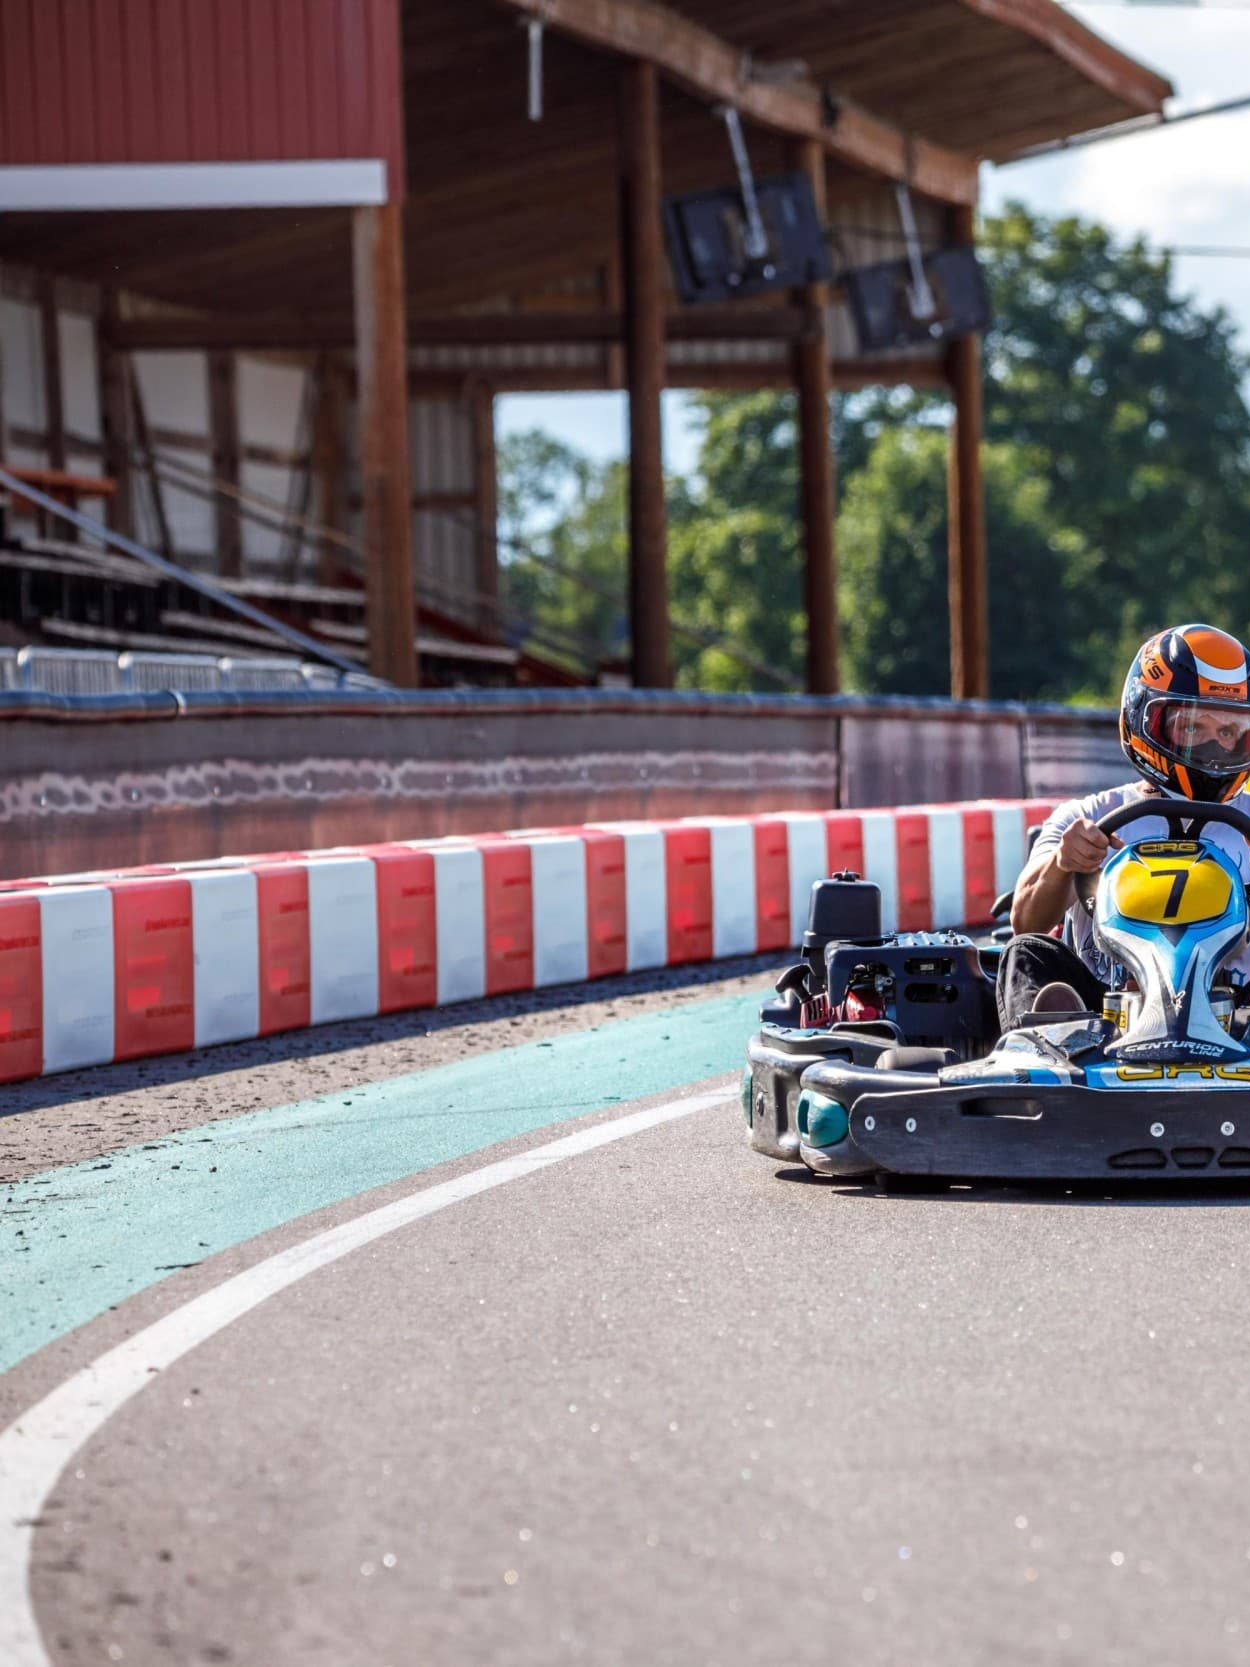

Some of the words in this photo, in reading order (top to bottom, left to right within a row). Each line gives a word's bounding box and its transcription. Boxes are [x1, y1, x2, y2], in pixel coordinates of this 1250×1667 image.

[1138, 842, 1198, 853] CRG
[1150, 869, 1190, 919] 7
[1125, 1040, 1225, 1054] CENTURION
[1189, 1049, 1222, 1058] LINE
